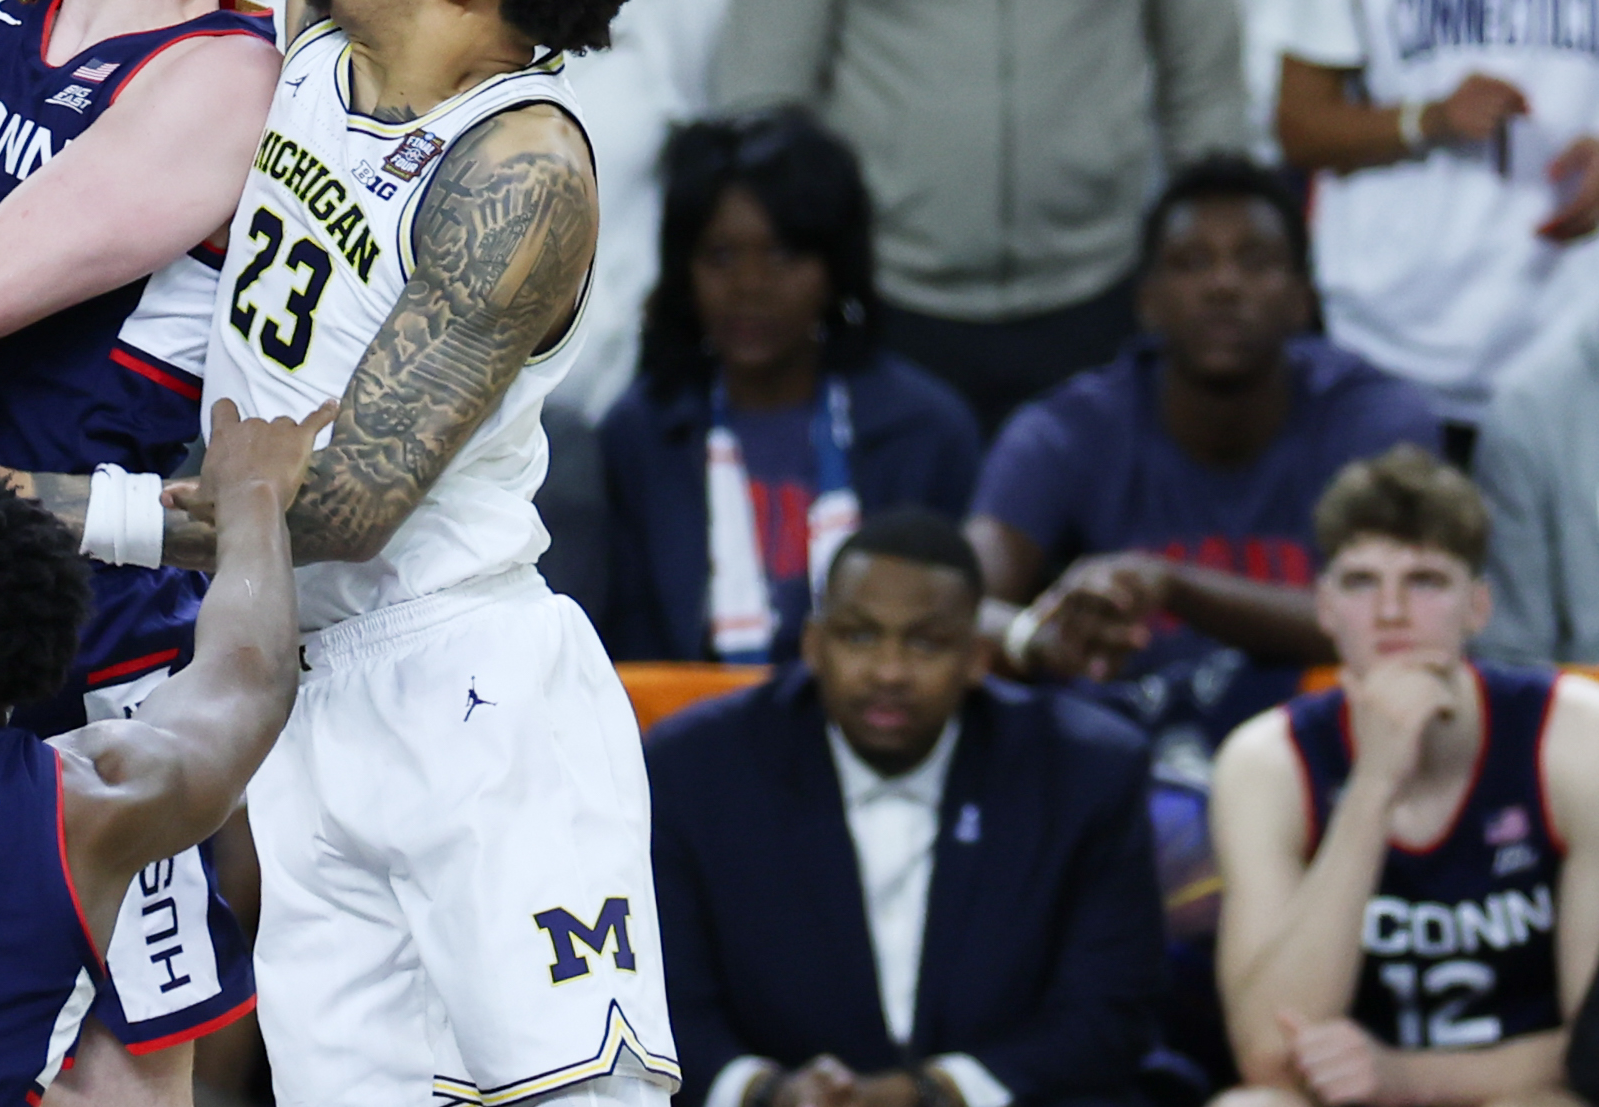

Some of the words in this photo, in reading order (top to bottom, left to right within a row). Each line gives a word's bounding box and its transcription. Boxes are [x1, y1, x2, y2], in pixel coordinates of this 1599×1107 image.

[53, 93, 93, 110] EAST
[63, 84, 93, 98] BIG
[389, 154, 419, 173] FOUR
[405, 136, 436, 156] FINAL
[230, 205, 332, 373] 23
[531, 896, 637, 986] M
[1362, 893, 1554, 956] CONN
[1378, 959, 1504, 1047] 12
